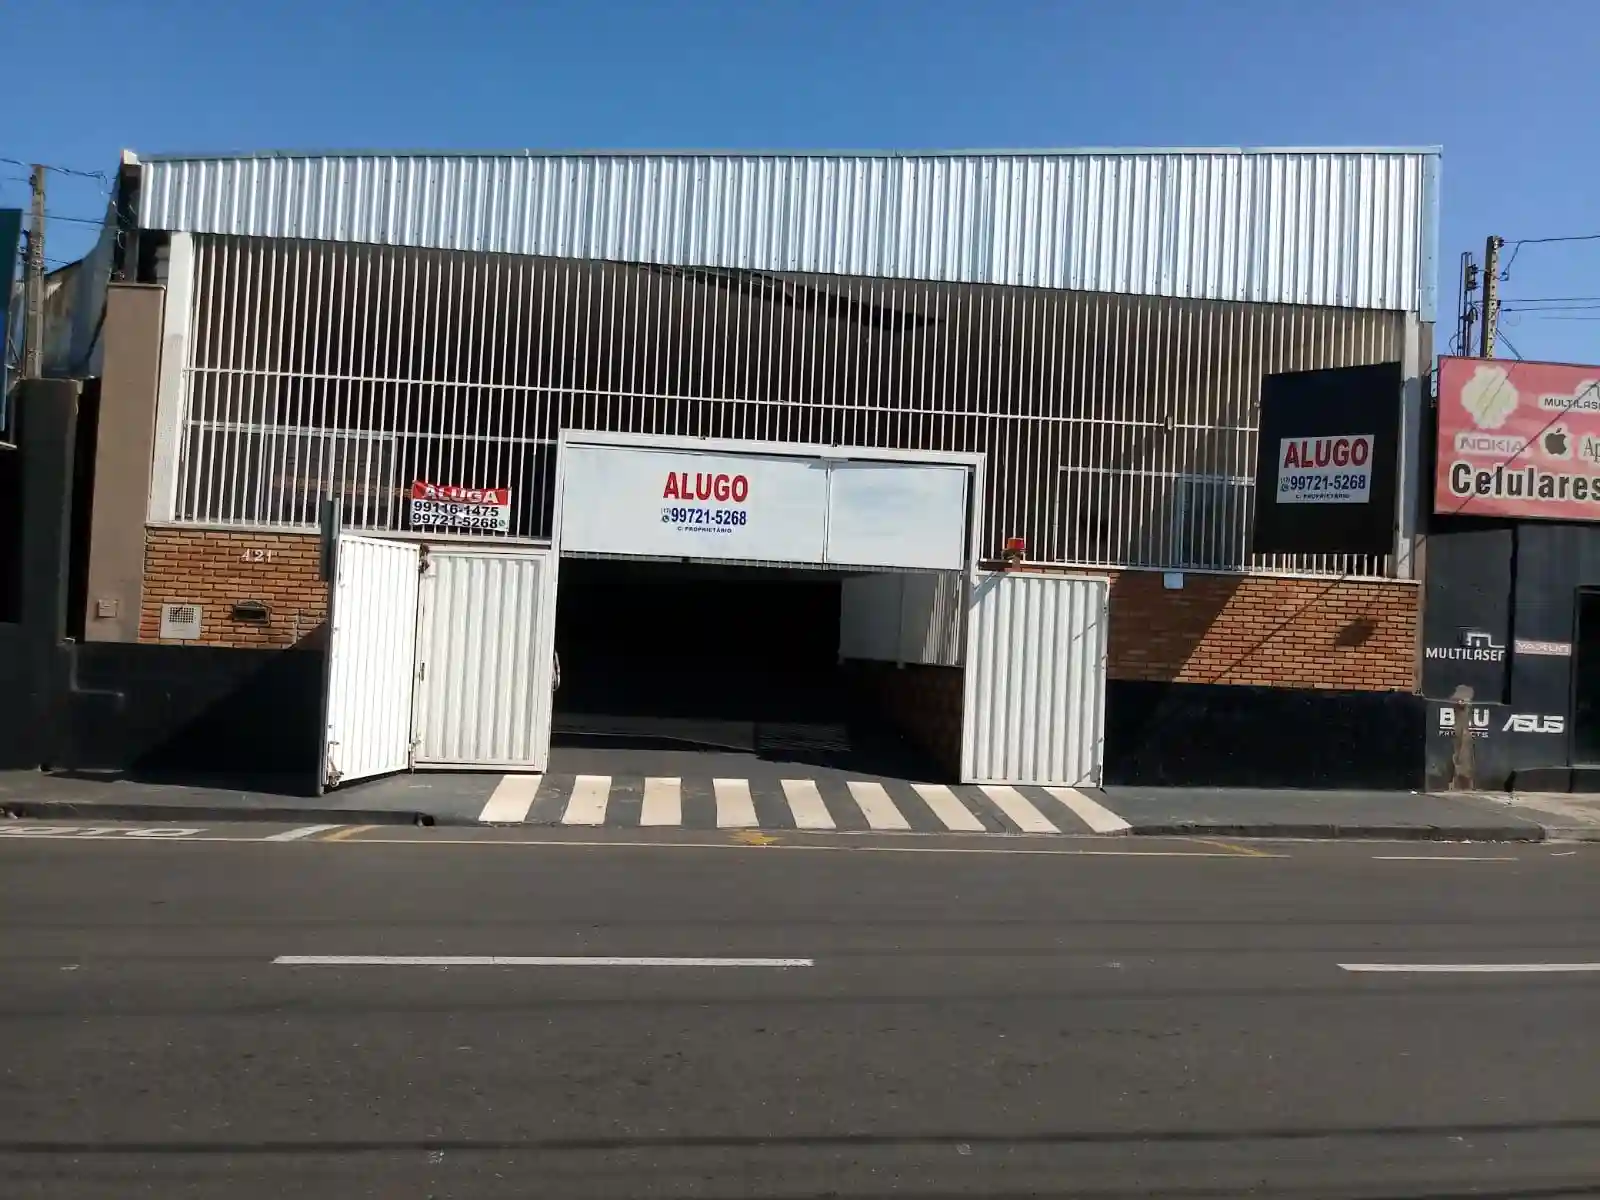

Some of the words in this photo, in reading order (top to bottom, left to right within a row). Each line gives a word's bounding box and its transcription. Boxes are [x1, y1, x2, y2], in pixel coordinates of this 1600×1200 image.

[1543, 396, 1600, 410] MULTILAS
[1283, 438, 1369, 469] ALUGO
[1459, 436, 1525, 453] NOKIA
[662, 471, 749, 502] ALUGO
[1290, 474, 1366, 491] 99721-5268
[1451, 463, 1600, 501] Celulares
[424, 484, 500, 504] ALUGA
[414, 501, 499, 517] 99116-1475
[671, 507, 747, 526] 99721-5268
[412, 512, 498, 529] 99721-5268
[241, 549, 272, 563] 421
[1439, 707, 1489, 727] BU
[1502, 714, 1564, 733] ASUS
